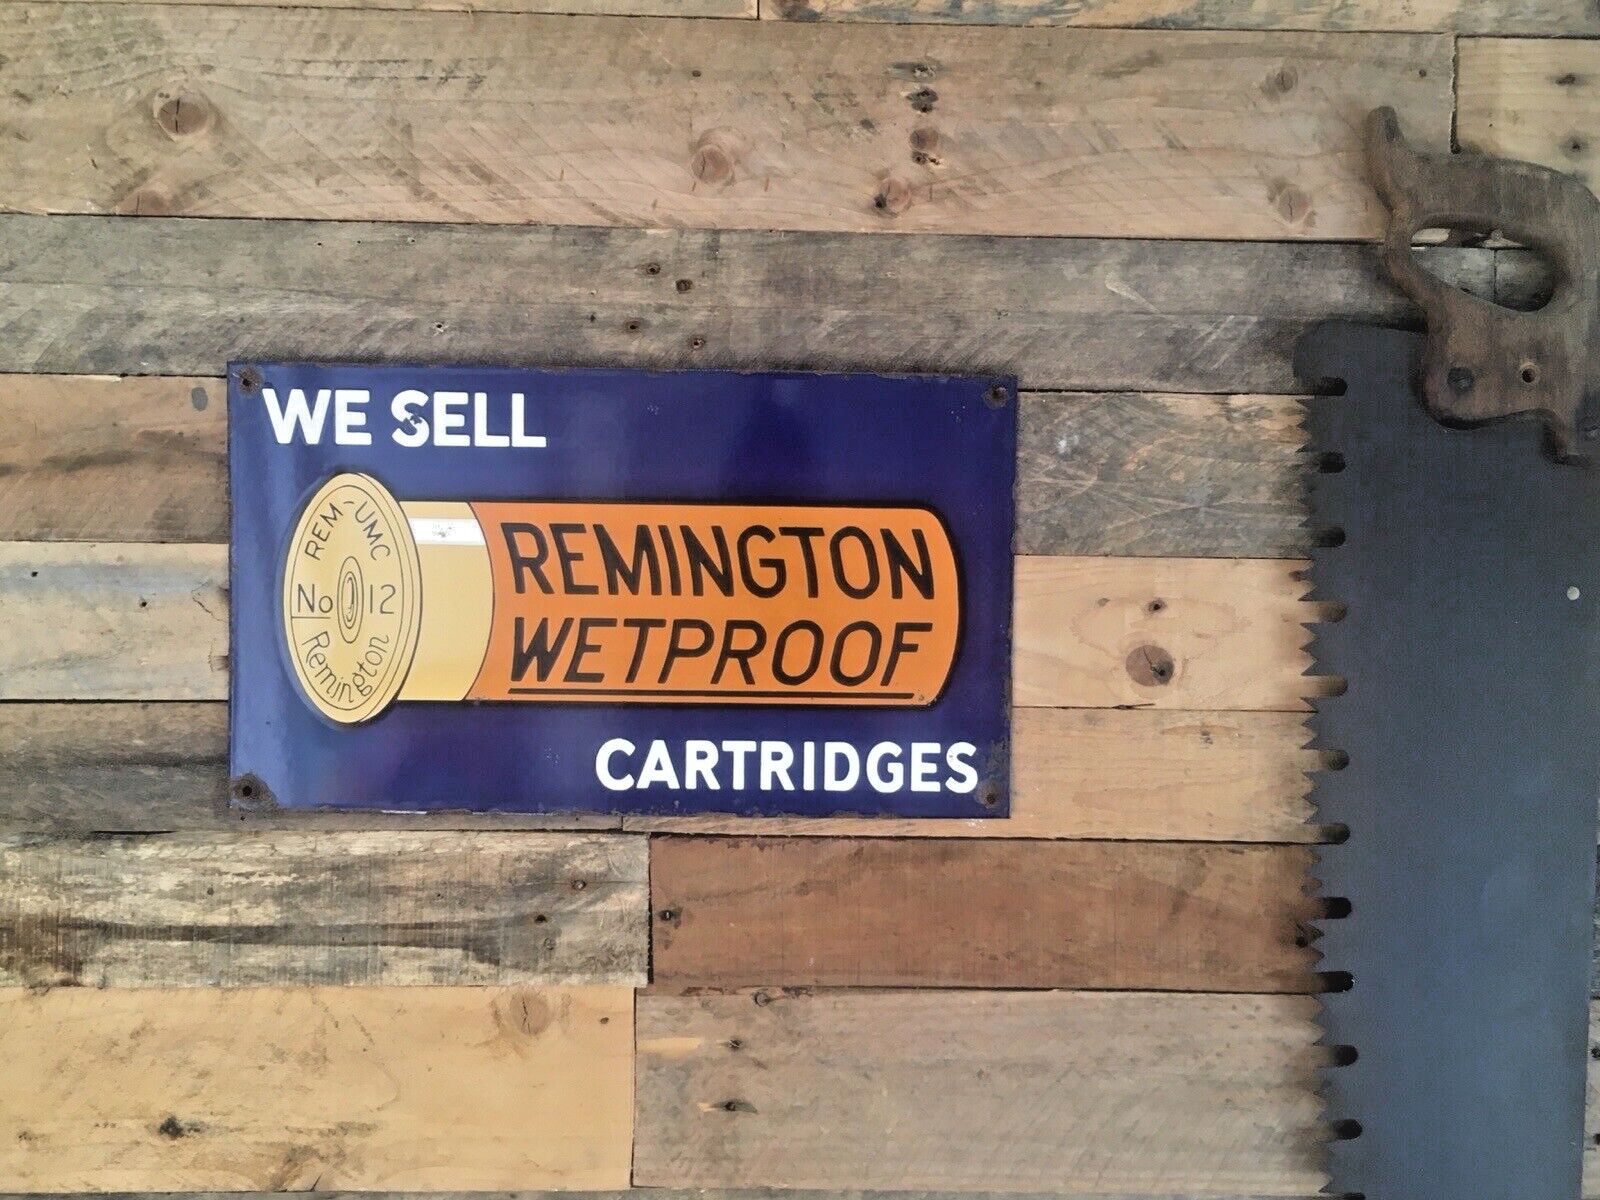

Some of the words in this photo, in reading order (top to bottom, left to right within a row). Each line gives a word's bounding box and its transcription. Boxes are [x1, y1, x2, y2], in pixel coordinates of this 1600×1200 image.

[262, 388, 372, 445] WE
[391, 389, 547, 448] SELL
[501, 522, 935, 600] REMINGTON
[370, 583, 396, 615] 12
[302, 630, 390, 703] Remington
[510, 616, 933, 687] WETPROOF
[595, 738, 979, 794] CARTRIDGES
